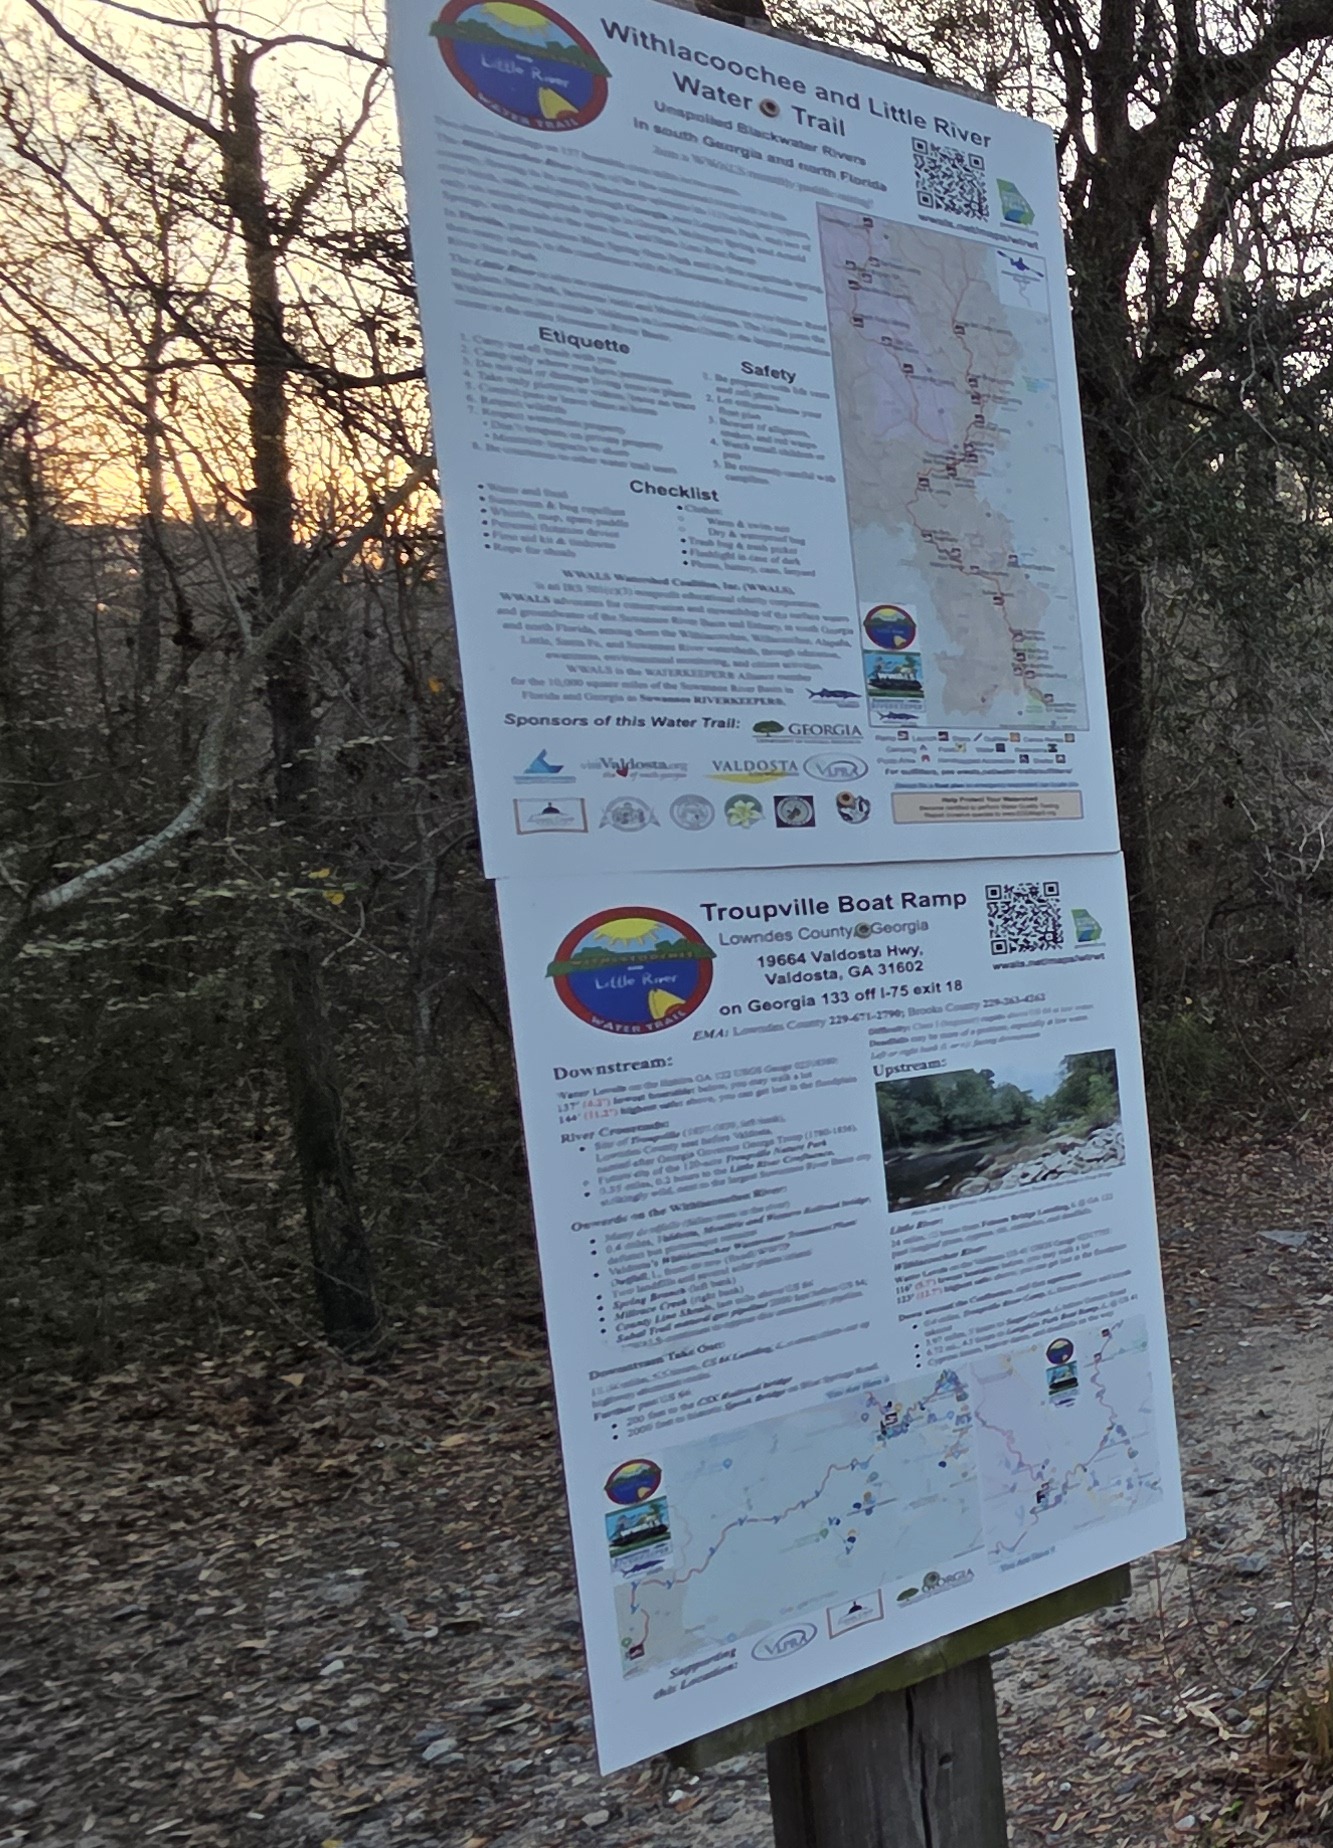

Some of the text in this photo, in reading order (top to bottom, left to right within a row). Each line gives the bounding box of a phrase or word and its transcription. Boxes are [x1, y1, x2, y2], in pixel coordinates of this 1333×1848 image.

[600, 17, 992, 148] Withlacoochee and Little River
[672, 70, 846, 137] Water Trail
[736, 122, 819, 153] Blackwater
[821, 144, 868, 166] Rivers
[839, 169, 888, 193] Florida
[538, 326, 631, 355] Etiquette
[740, 360, 797, 384] Safety
[629, 479, 720, 502] Checklist
[504, 713, 741, 729] Sponsors of this Water Trail:
[788, 723, 862, 736] GEORGIA
[712, 760, 799, 772] VALDOSTA
[699, 891, 967, 922] Troupville Boat Ramp
[718, 927, 794, 946] Lowndes
[870, 920, 929, 936] Georgia
[756, 953, 807, 968] 19664
[810, 947, 883, 964] Valdosta
[764, 960, 924, 986] Valdosta, GA 31602
[718, 979, 963, 1016] on Georgia 133 off I-75 exit 18
[591, 1009, 687, 1033] WATER TRAIL
[553, 1056, 673, 1081] Downstream:
[873, 1057, 947, 1078] Upstream:
